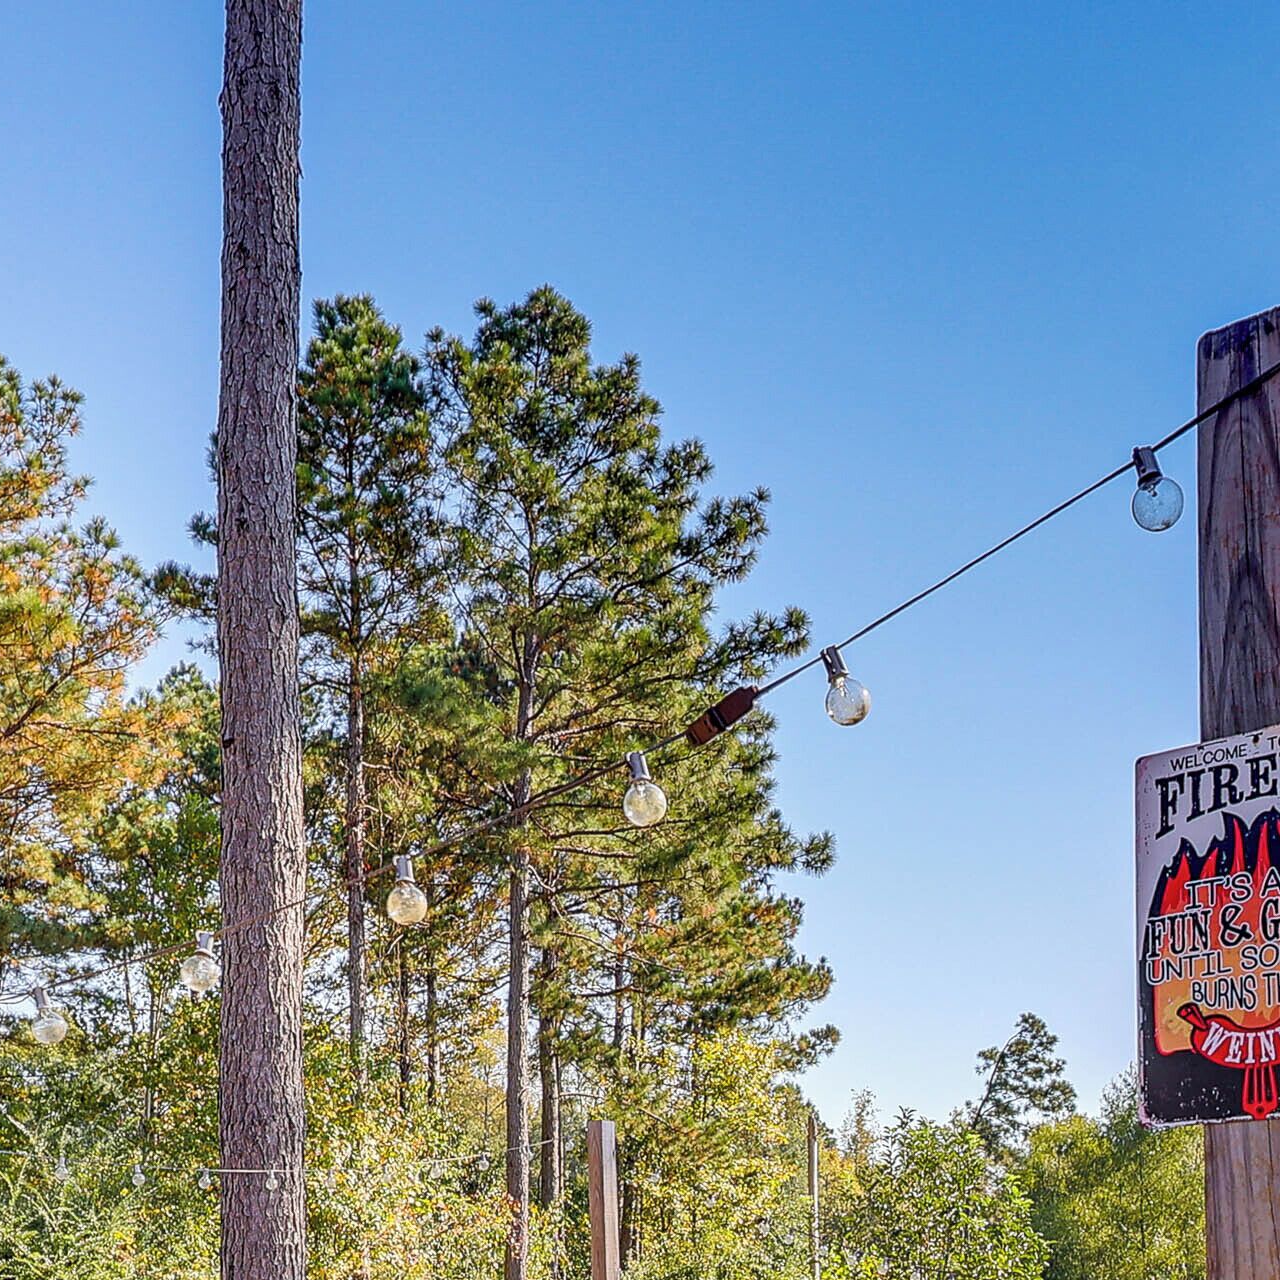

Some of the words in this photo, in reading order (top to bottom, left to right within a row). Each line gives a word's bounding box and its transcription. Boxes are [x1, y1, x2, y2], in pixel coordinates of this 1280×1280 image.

[1170, 743, 1248, 772] WELCOME
[1186, 871, 1252, 910] IT'S
[1147, 912, 1210, 960] FUN
[1219, 905, 1254, 945] &
[1147, 951, 1232, 984] UNTIL
[1192, 980, 1257, 1010] BURNS
